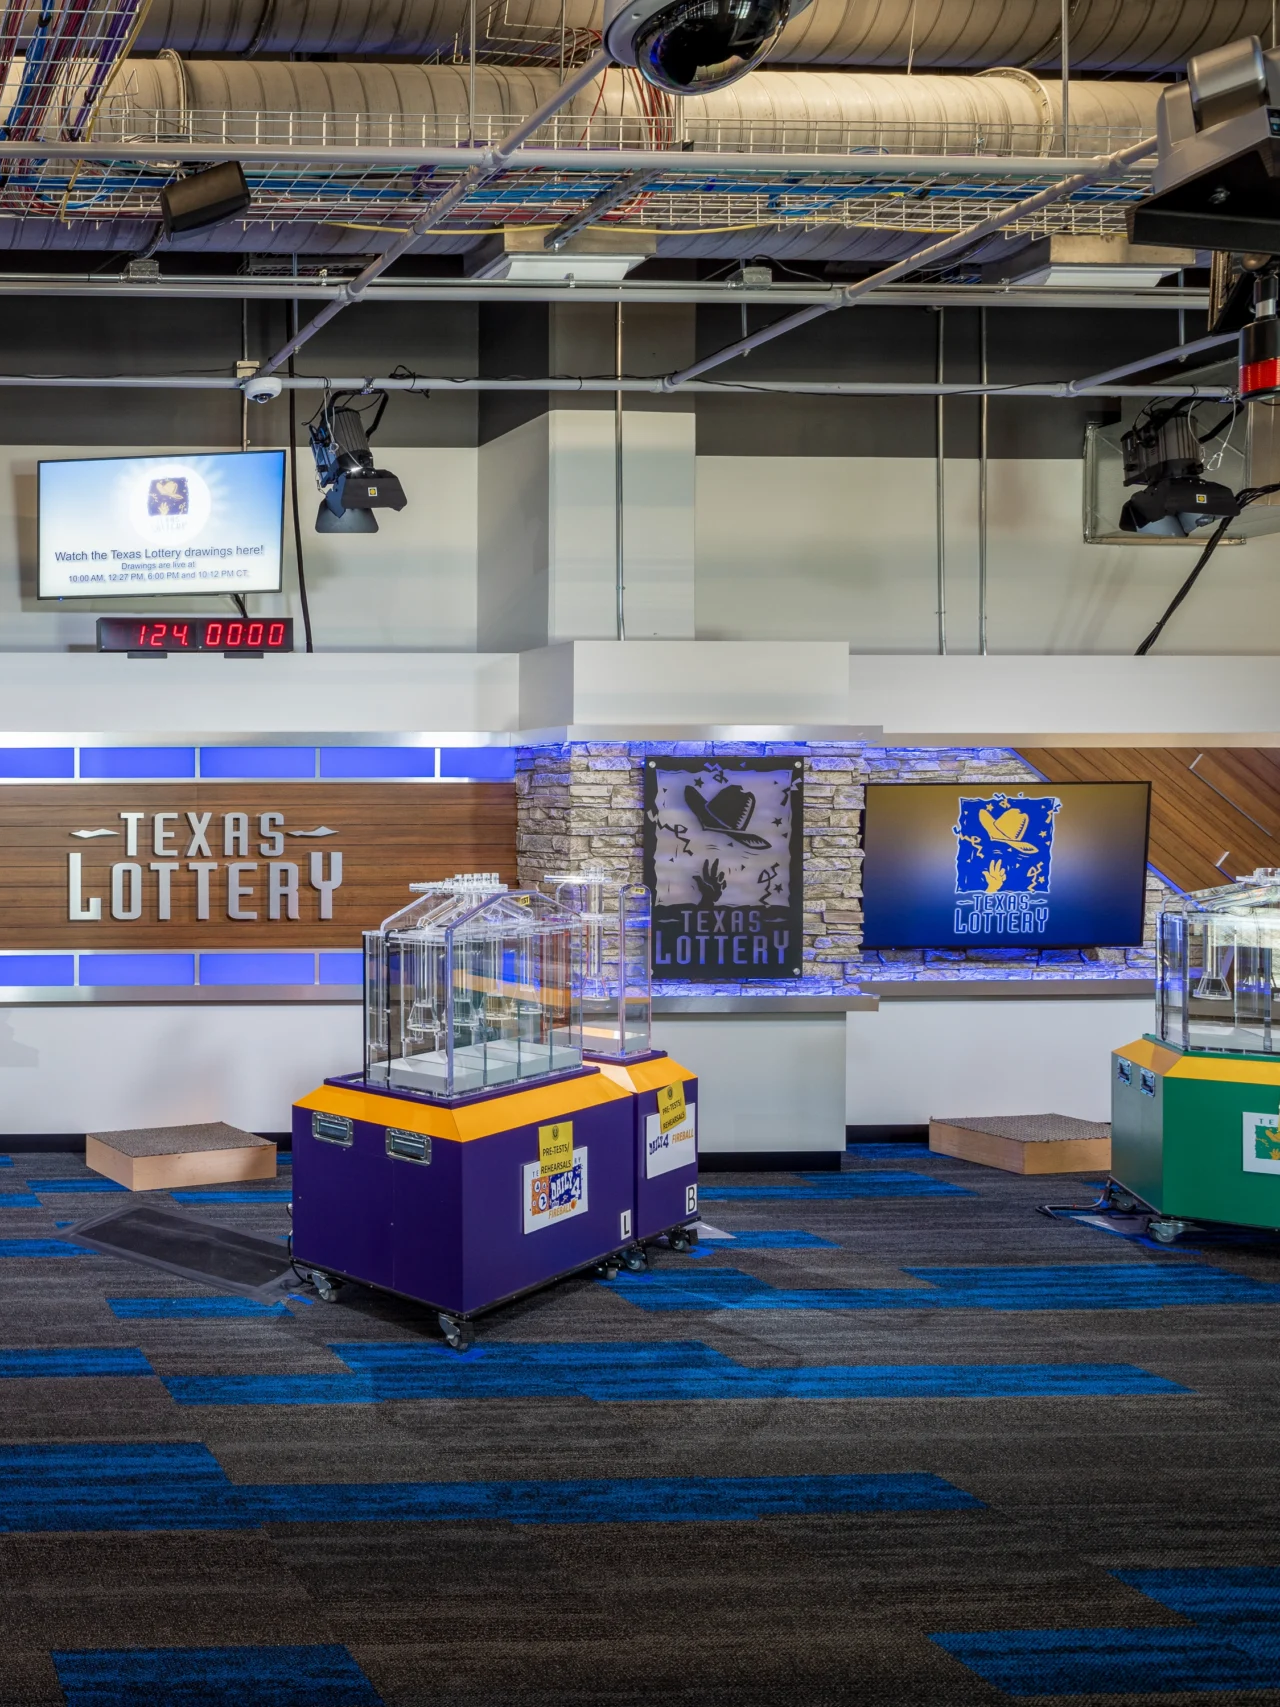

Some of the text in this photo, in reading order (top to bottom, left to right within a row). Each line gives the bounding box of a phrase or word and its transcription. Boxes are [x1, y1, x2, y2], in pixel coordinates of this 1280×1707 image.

[54, 545, 264, 561] Watch the Texas Lottery drawings here!
[121, 562, 156, 570] Drawings
[69, 574, 89, 582] 10:00
[108, 573, 129, 581] 12:27
[148, 572, 164, 580] 6:00
[167, 571, 179, 579] PM
[181, 571, 196, 579] and
[198, 570, 219, 578] 10:12
[119, 812, 285, 857] TEXAS
[68, 851, 343, 921] LOTTERY
[972, 893, 1030, 912] TEXAS
[680, 910, 761, 933] TEXAS
[953, 907, 1049, 934] LOTTERY
[655, 930, 790, 965] LOTTERY
[663, 1111, 685, 1128] REHEARSALS
[672, 1128, 694, 1144] FIREBALL
[542, 1141, 570, 1157] PRE-TESTS/
[540, 1159, 572, 1175] REHEARSALS
[551, 1171, 581, 1200] DAILY 4
[688, 1187, 696, 1212] B
[548, 1203, 572, 1219] FIREBALL
[623, 1215, 630, 1236] L
